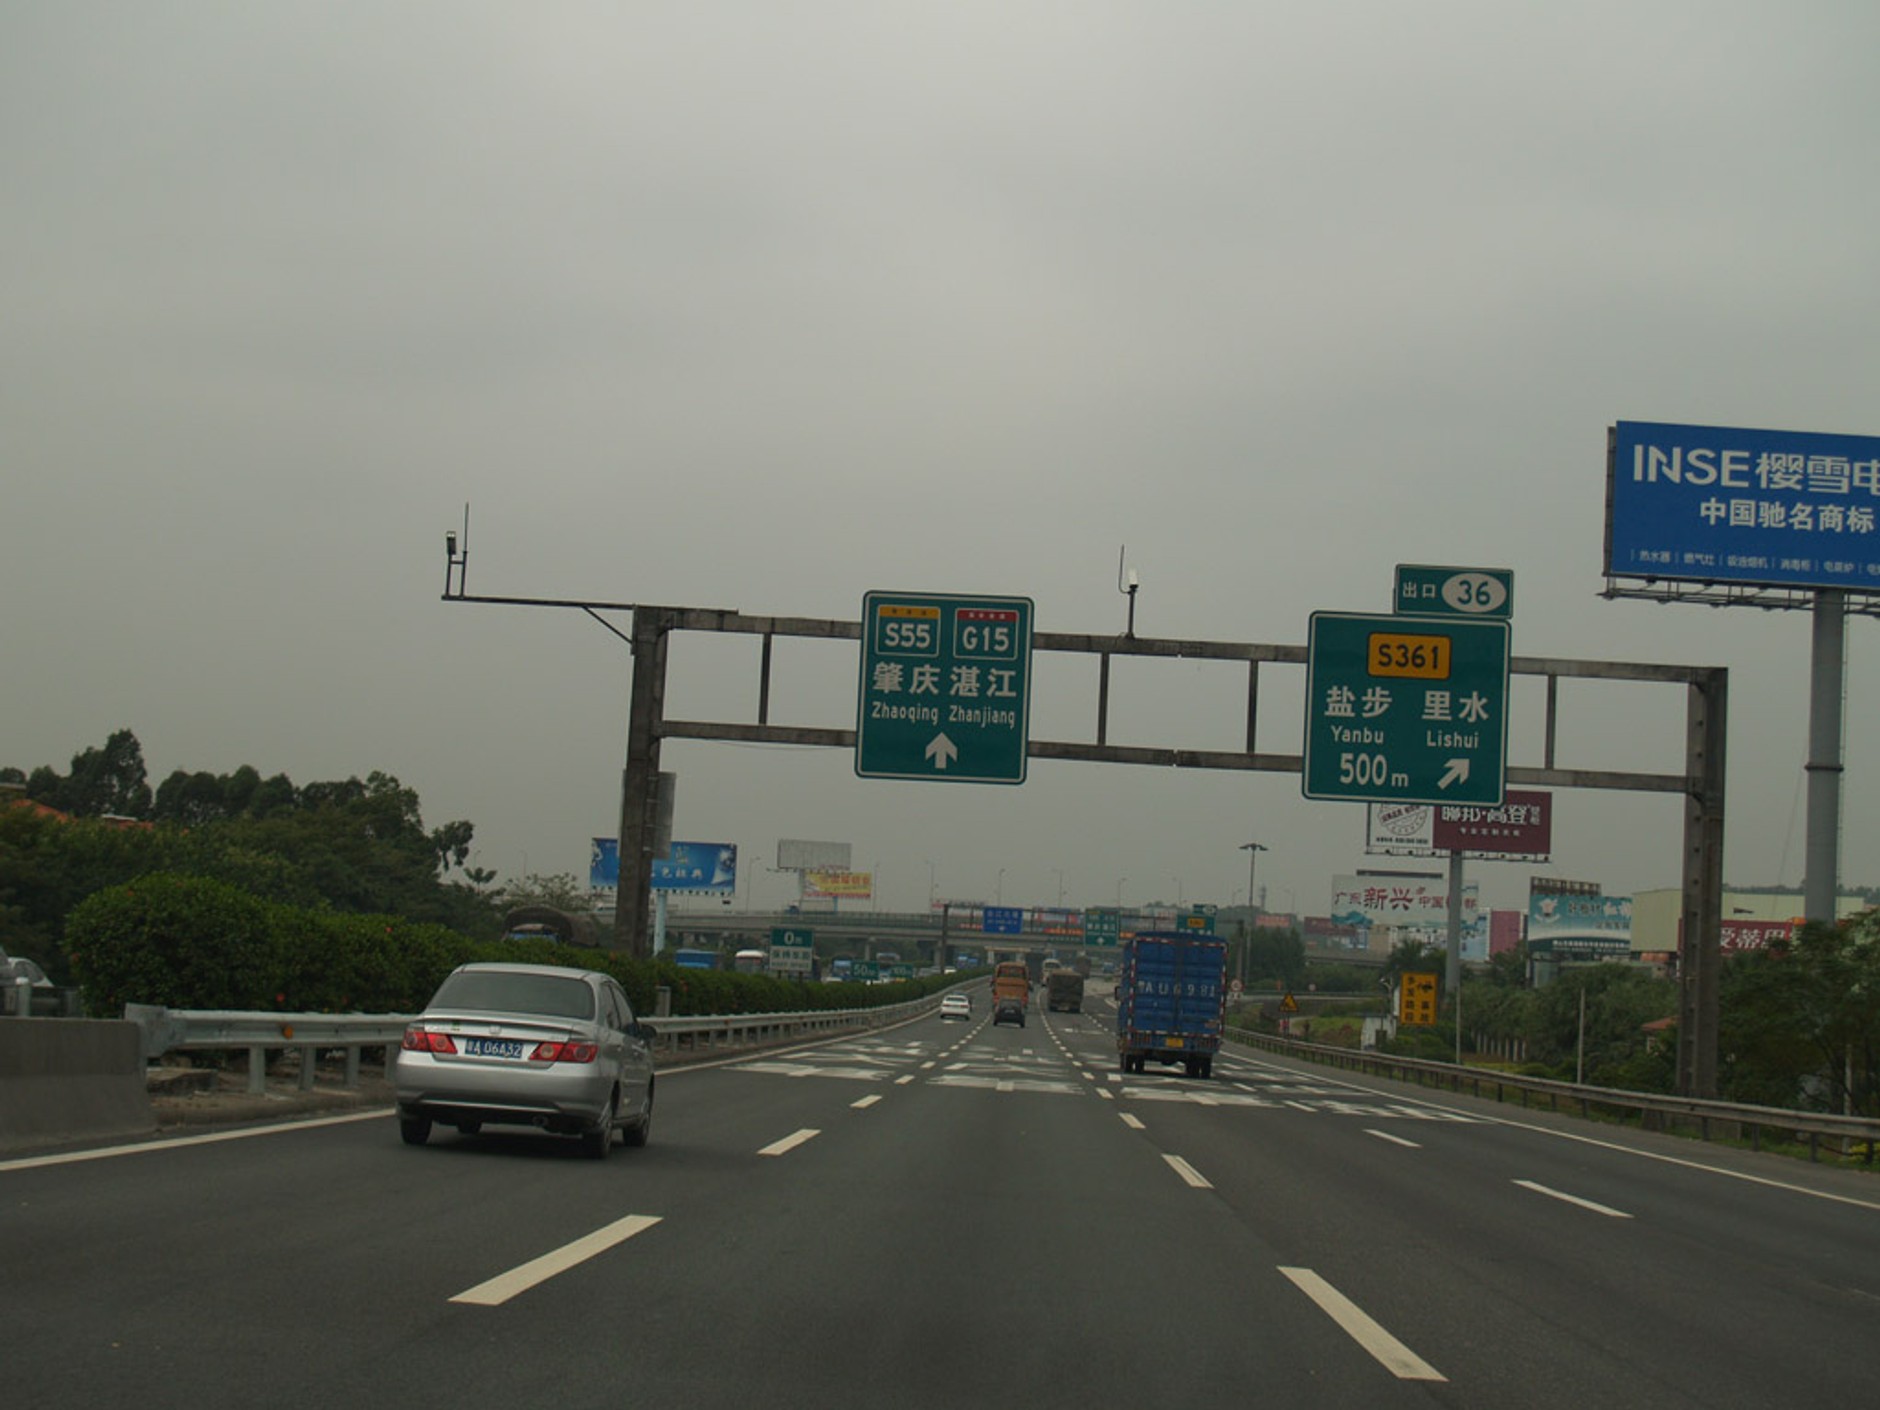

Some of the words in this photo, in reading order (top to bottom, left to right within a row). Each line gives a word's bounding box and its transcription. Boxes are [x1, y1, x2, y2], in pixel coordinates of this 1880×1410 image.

[1700, 497, 1875, 534] 中国驰名商标
[1402, 581, 1436, 598] 出口
[1457, 579, 1491, 606] 36
[884, 622, 931, 648] S55
[962, 626, 1009, 652] G15
[1377, 643, 1440, 669] S361
[872, 661, 941, 695] 肇庆
[950, 665, 1017, 697] 湛江
[871, 701, 939, 726] Zhaoqing
[949, 705, 1016, 730] Zhanjiang
[1324, 686, 1393, 719] 盐步
[1421, 690, 1489, 724] 里水
[1330, 725, 1384, 745] Yanbu
[1426, 730, 1479, 749] Lishui
